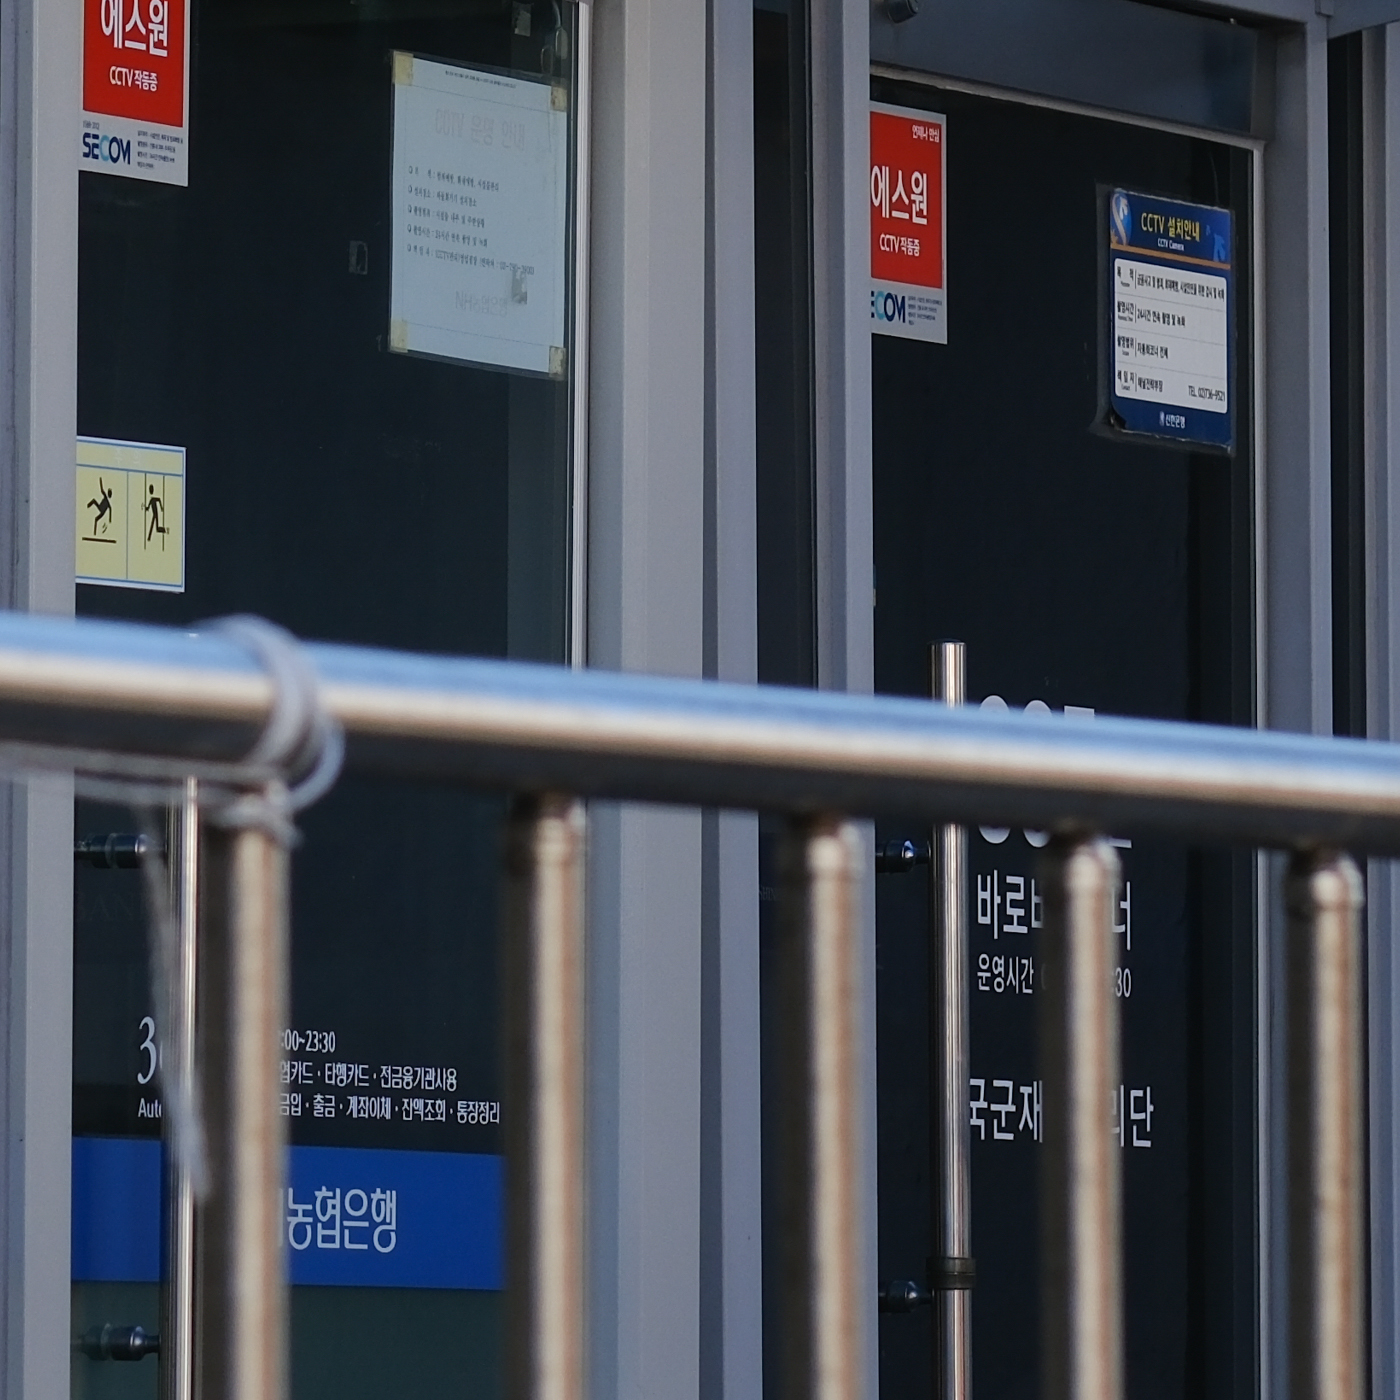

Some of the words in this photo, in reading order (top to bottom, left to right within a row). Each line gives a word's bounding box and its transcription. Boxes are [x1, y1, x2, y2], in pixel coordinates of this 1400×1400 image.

[109, 65, 135, 88] CCTV
[82, 132, 131, 165] SECOM
[870, 164, 928, 226] 에스원
[1141, 212, 1165, 234] CCTV
[1167, 217, 1200, 243] 설치안내
[879, 233, 900, 254] CCTV
[871, 290, 906, 325] COM
[977, 953, 1035, 995] 운영시간
[324, 1061, 370, 1087] 타행카드
[379, 1064, 458, 1092] 전금융기관사용
[137, 1097, 162, 1119] Aut
[313, 1093, 336, 1118] 출금
[345, 1094, 392, 1121] 계좌이체
[401, 1097, 447, 1123] 잔액조회
[456, 1100, 501, 1125] 통장정리
